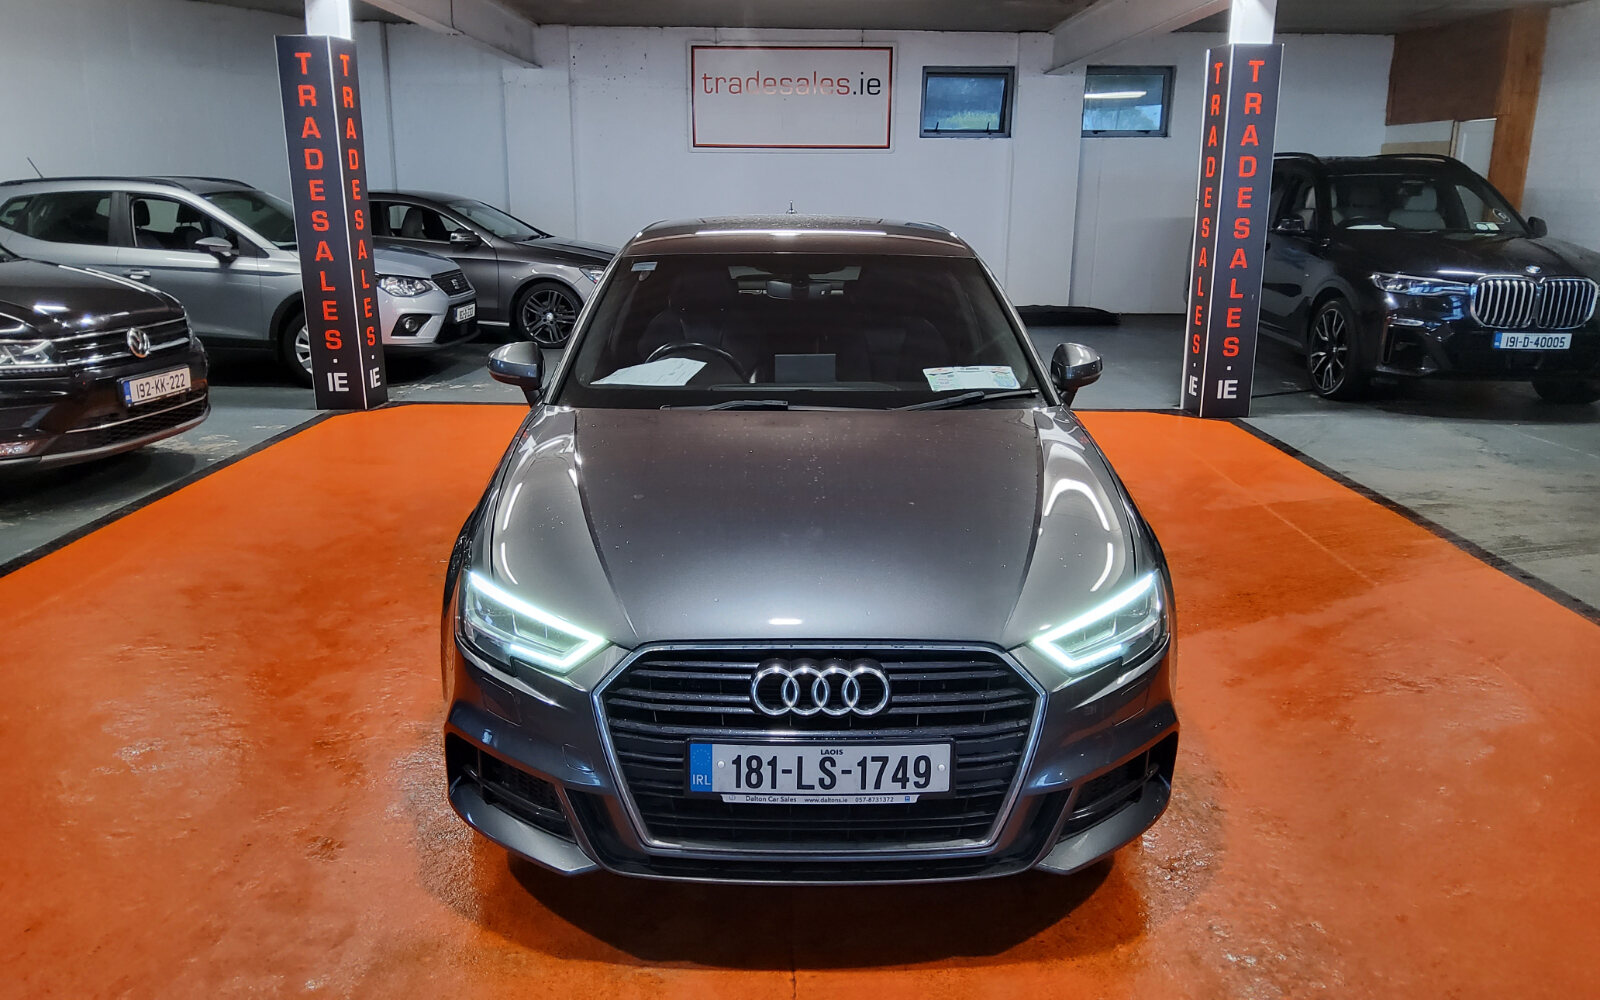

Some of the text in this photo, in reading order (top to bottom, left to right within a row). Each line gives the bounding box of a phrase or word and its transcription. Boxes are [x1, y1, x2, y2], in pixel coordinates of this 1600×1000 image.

[701, 70, 882, 96] tradesales.ie
[1505, 336, 1566, 348] 191-D-40005
[135, 373, 186, 400] 192-KK-222
[692, 774, 712, 786] IRL
[731, 754, 932, 791] 181-LS-1749
[745, 795, 767, 803] Dalton
